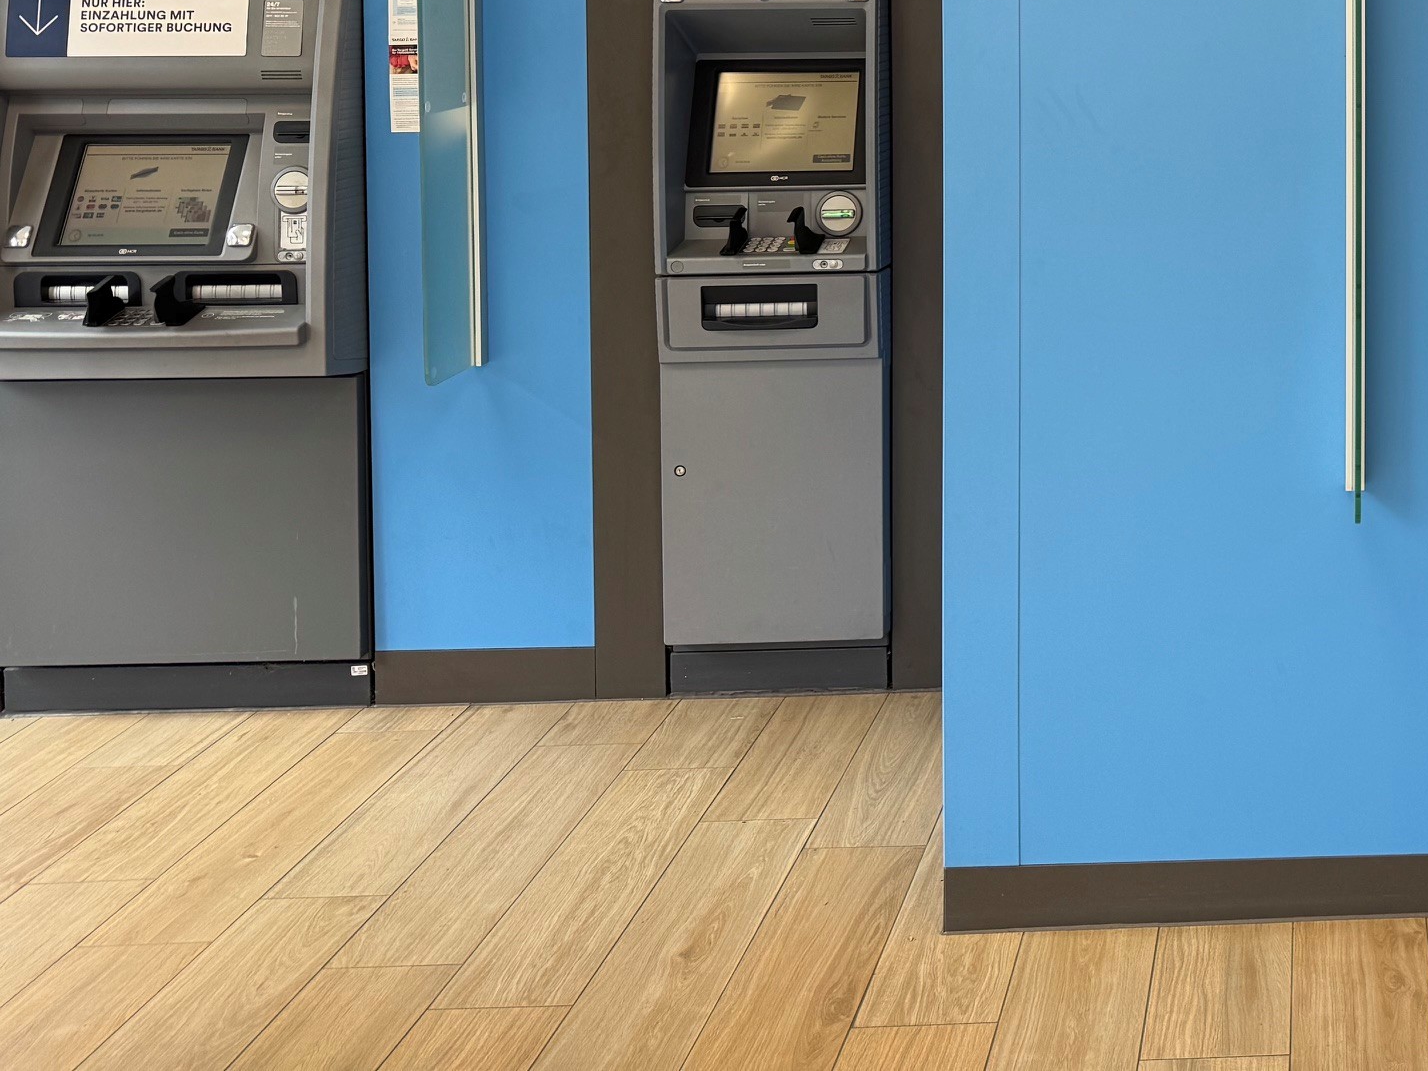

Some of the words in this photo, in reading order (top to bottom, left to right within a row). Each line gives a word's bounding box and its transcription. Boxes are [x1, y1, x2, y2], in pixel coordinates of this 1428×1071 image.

[80, 10, 166, 21] EINZAHLUNG
[170, 10, 195, 20] MIT
[80, 22, 163, 33] SOFORTIGER
[166, 22, 232, 33] BUCHUNG
